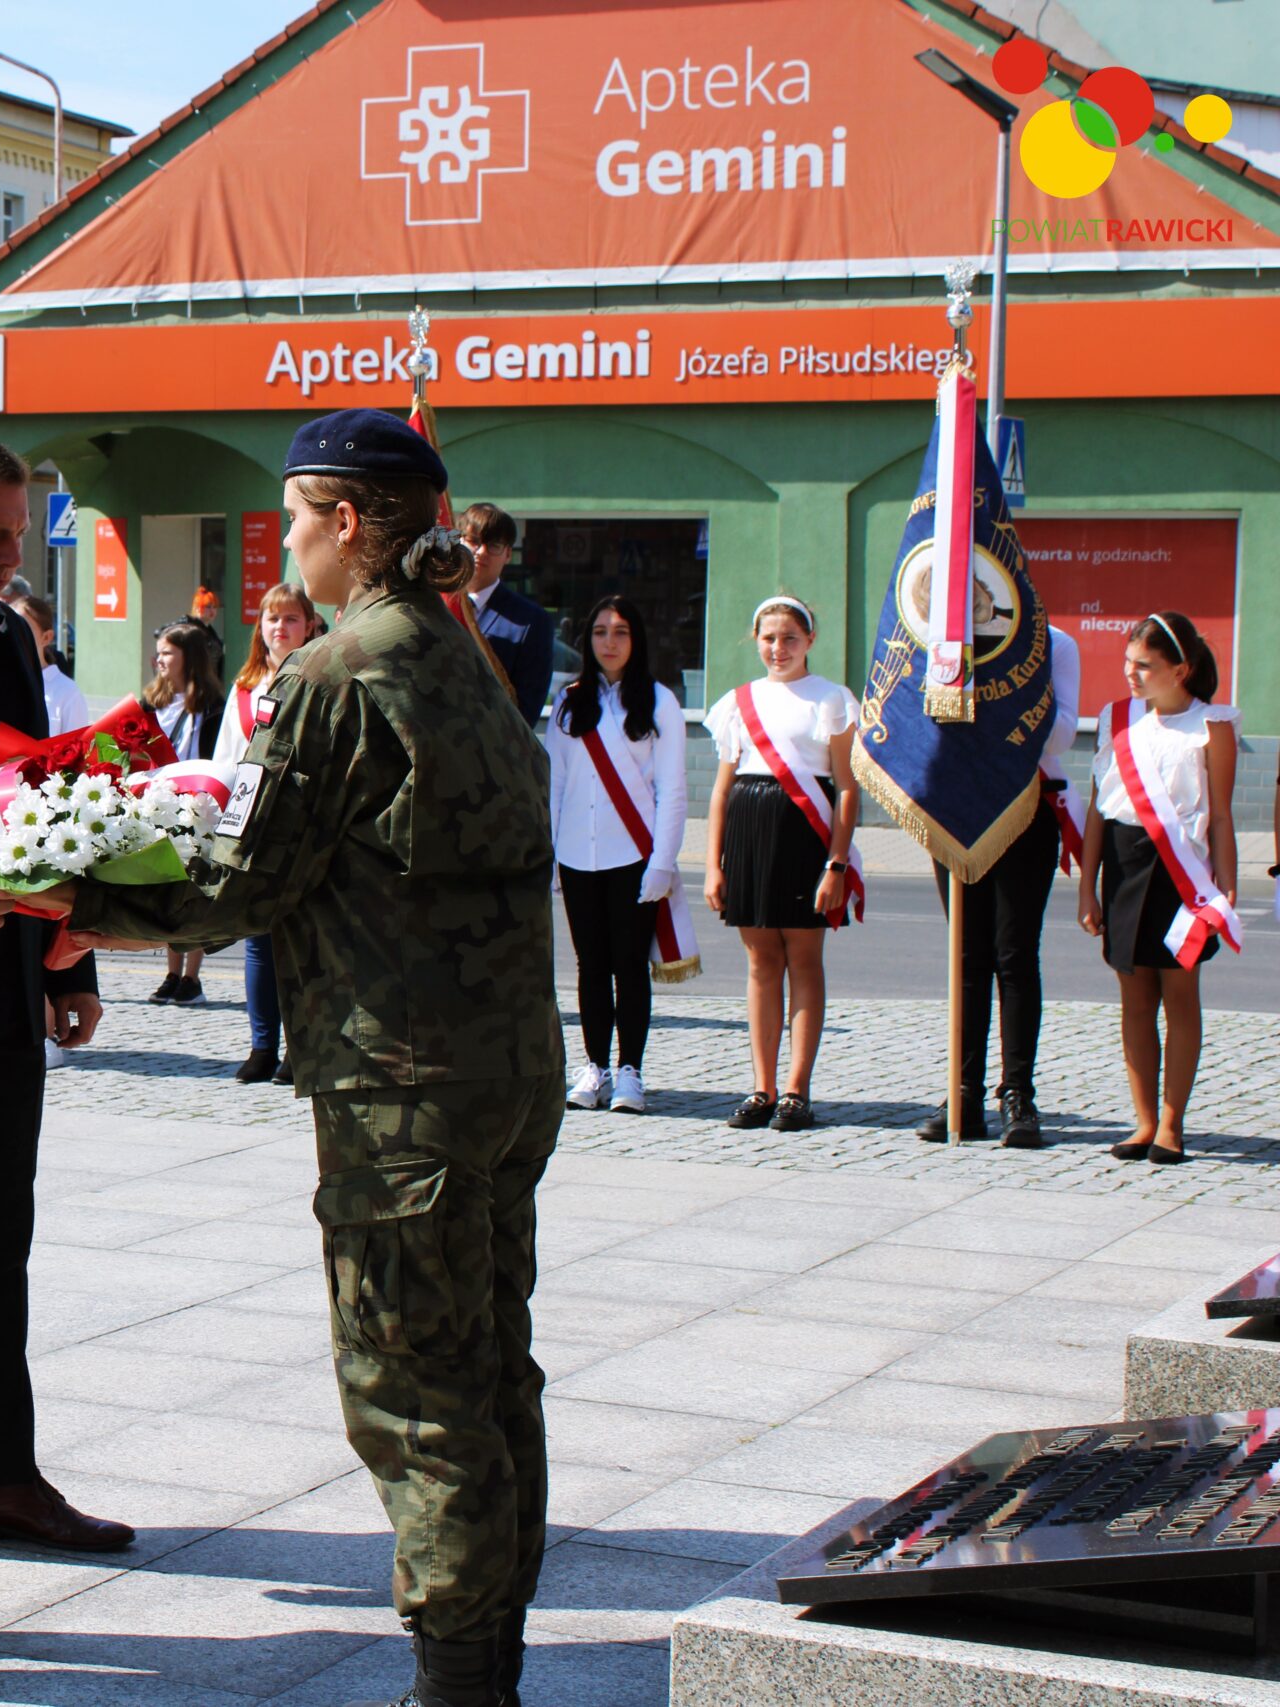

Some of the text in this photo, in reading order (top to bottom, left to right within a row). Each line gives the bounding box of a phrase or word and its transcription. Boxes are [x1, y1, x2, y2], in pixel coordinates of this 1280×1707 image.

[593, 46, 810, 130] Apteka
[596, 126, 847, 197] Gemini
[265, 336, 439, 395] Apteka
[456, 329, 650, 380] Gemini
[675, 346, 769, 382] Józefa
[1093, 547, 1172, 566] godzinach:
